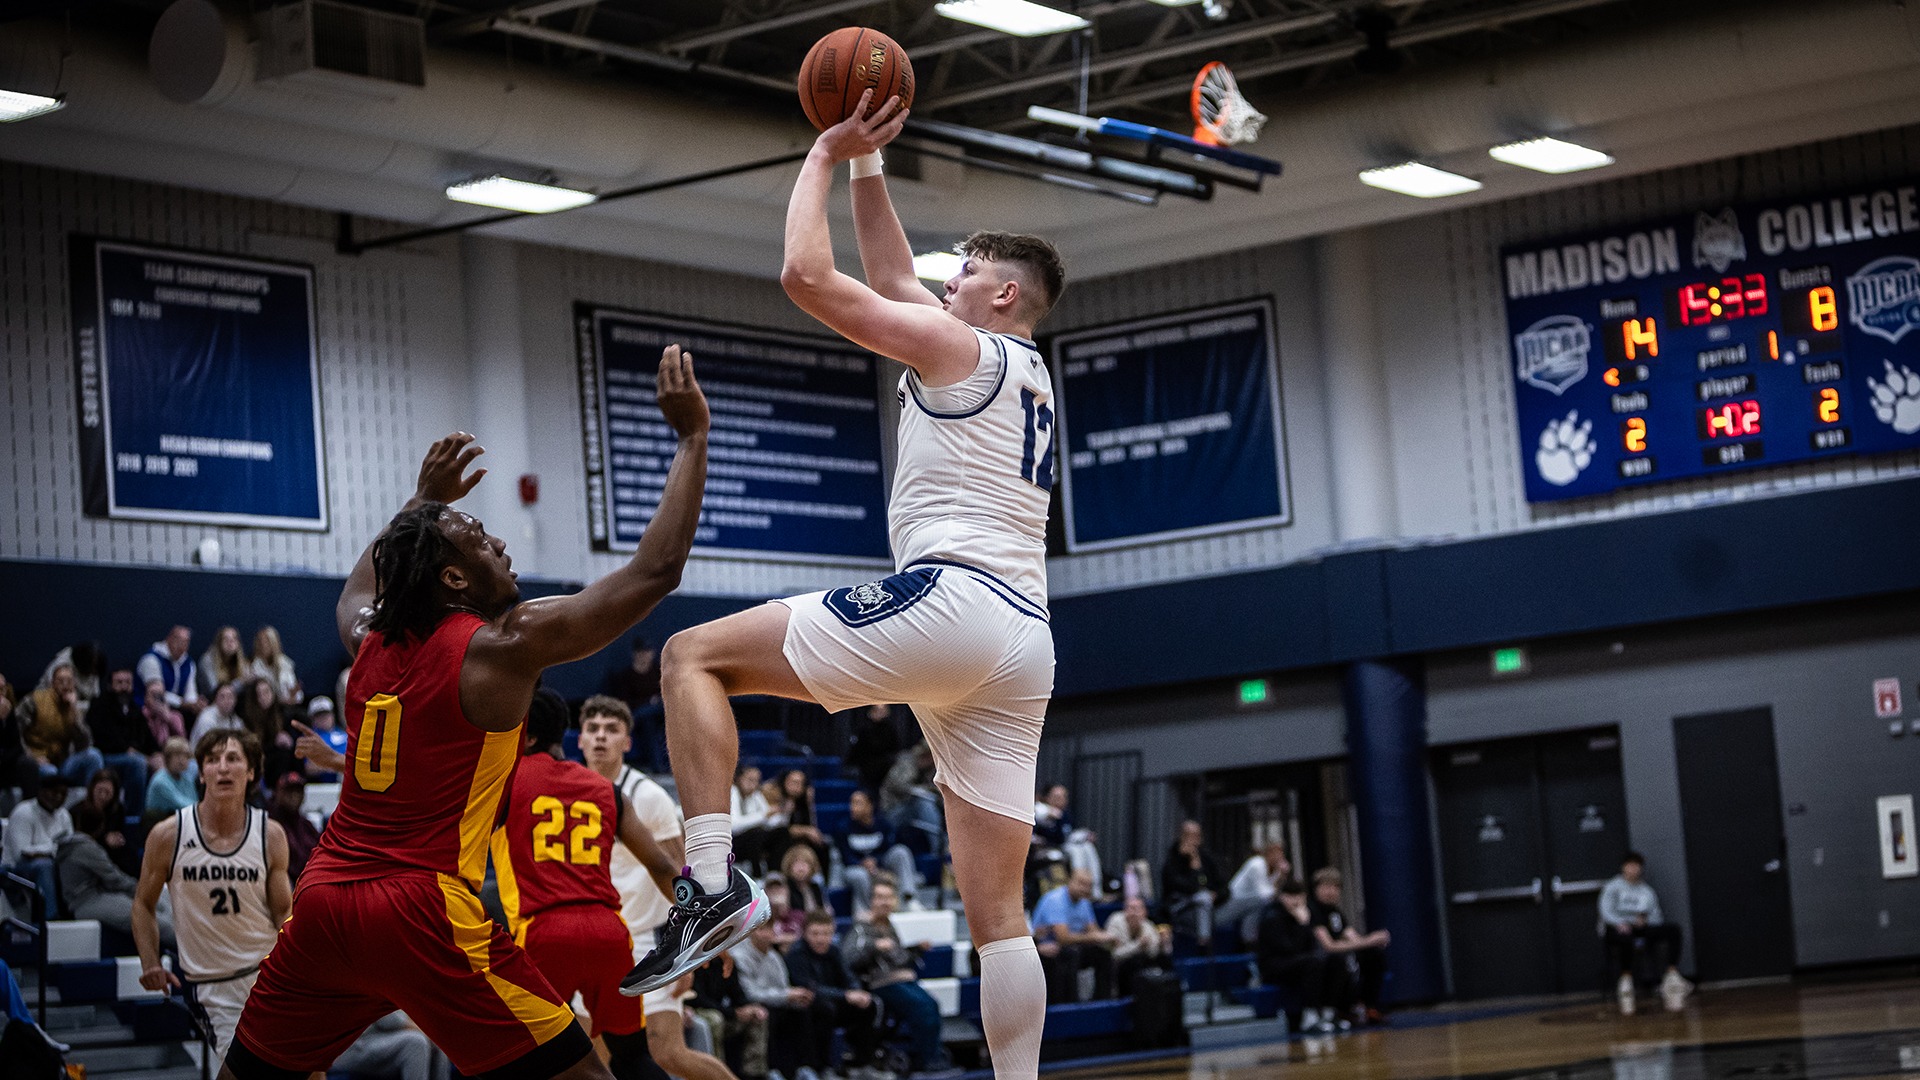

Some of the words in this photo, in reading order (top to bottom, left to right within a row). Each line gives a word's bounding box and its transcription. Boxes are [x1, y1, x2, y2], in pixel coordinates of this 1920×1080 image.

[1506, 228, 1680, 298] MADISON
[1757, 187, 1920, 255] COLLEGE
[1679, 273, 1768, 326] 15:33
[1809, 286, 1838, 332] 8
[1623, 317, 1658, 360] 14
[1767, 329, 1779, 360] 1
[1698, 343, 1747, 371] period
[1804, 363, 1840, 383] fouls
[1611, 391, 1648, 413] fouls
[1700, 375, 1749, 401] player
[1819, 388, 1840, 423] 2
[1020, 384, 1053, 493] 12
[1626, 417, 1646, 452] 2
[354, 692, 403, 793] 0
[531, 795, 602, 866] 22
[183, 865, 259, 882] MADISON
[210, 886, 240, 915] 21
